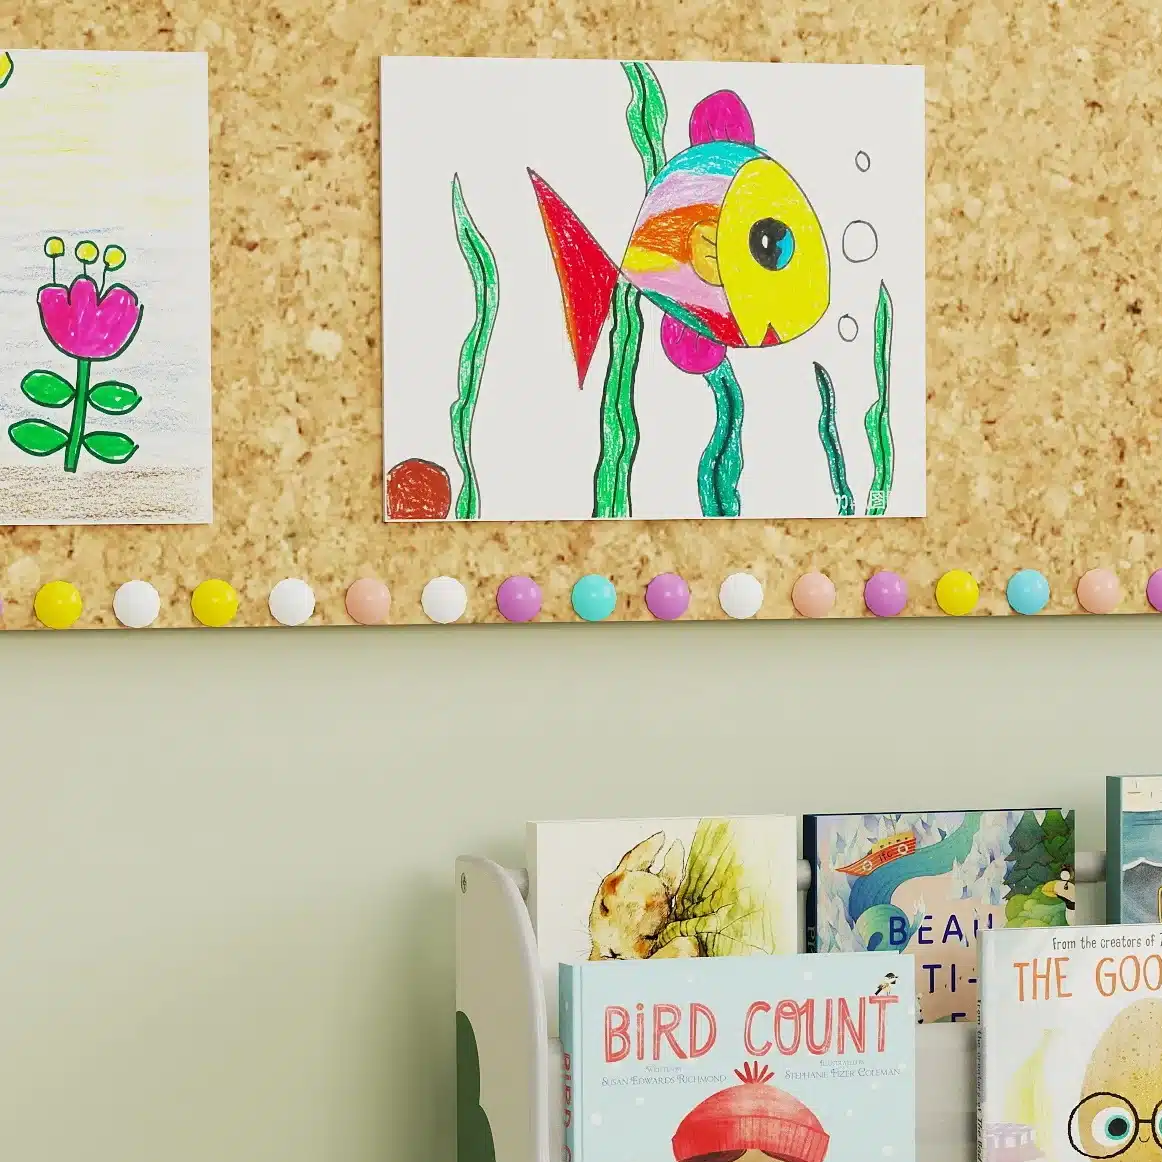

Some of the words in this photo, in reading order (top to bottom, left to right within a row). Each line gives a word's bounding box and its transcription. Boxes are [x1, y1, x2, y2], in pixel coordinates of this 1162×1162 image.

[1080, 935, 1097, 949] the
[1100, 936, 1142, 949] creators
[1145, 934, 1156, 947] of
[1013, 957, 1072, 1001] THE
[744, 995, 899, 1056] COUNT
